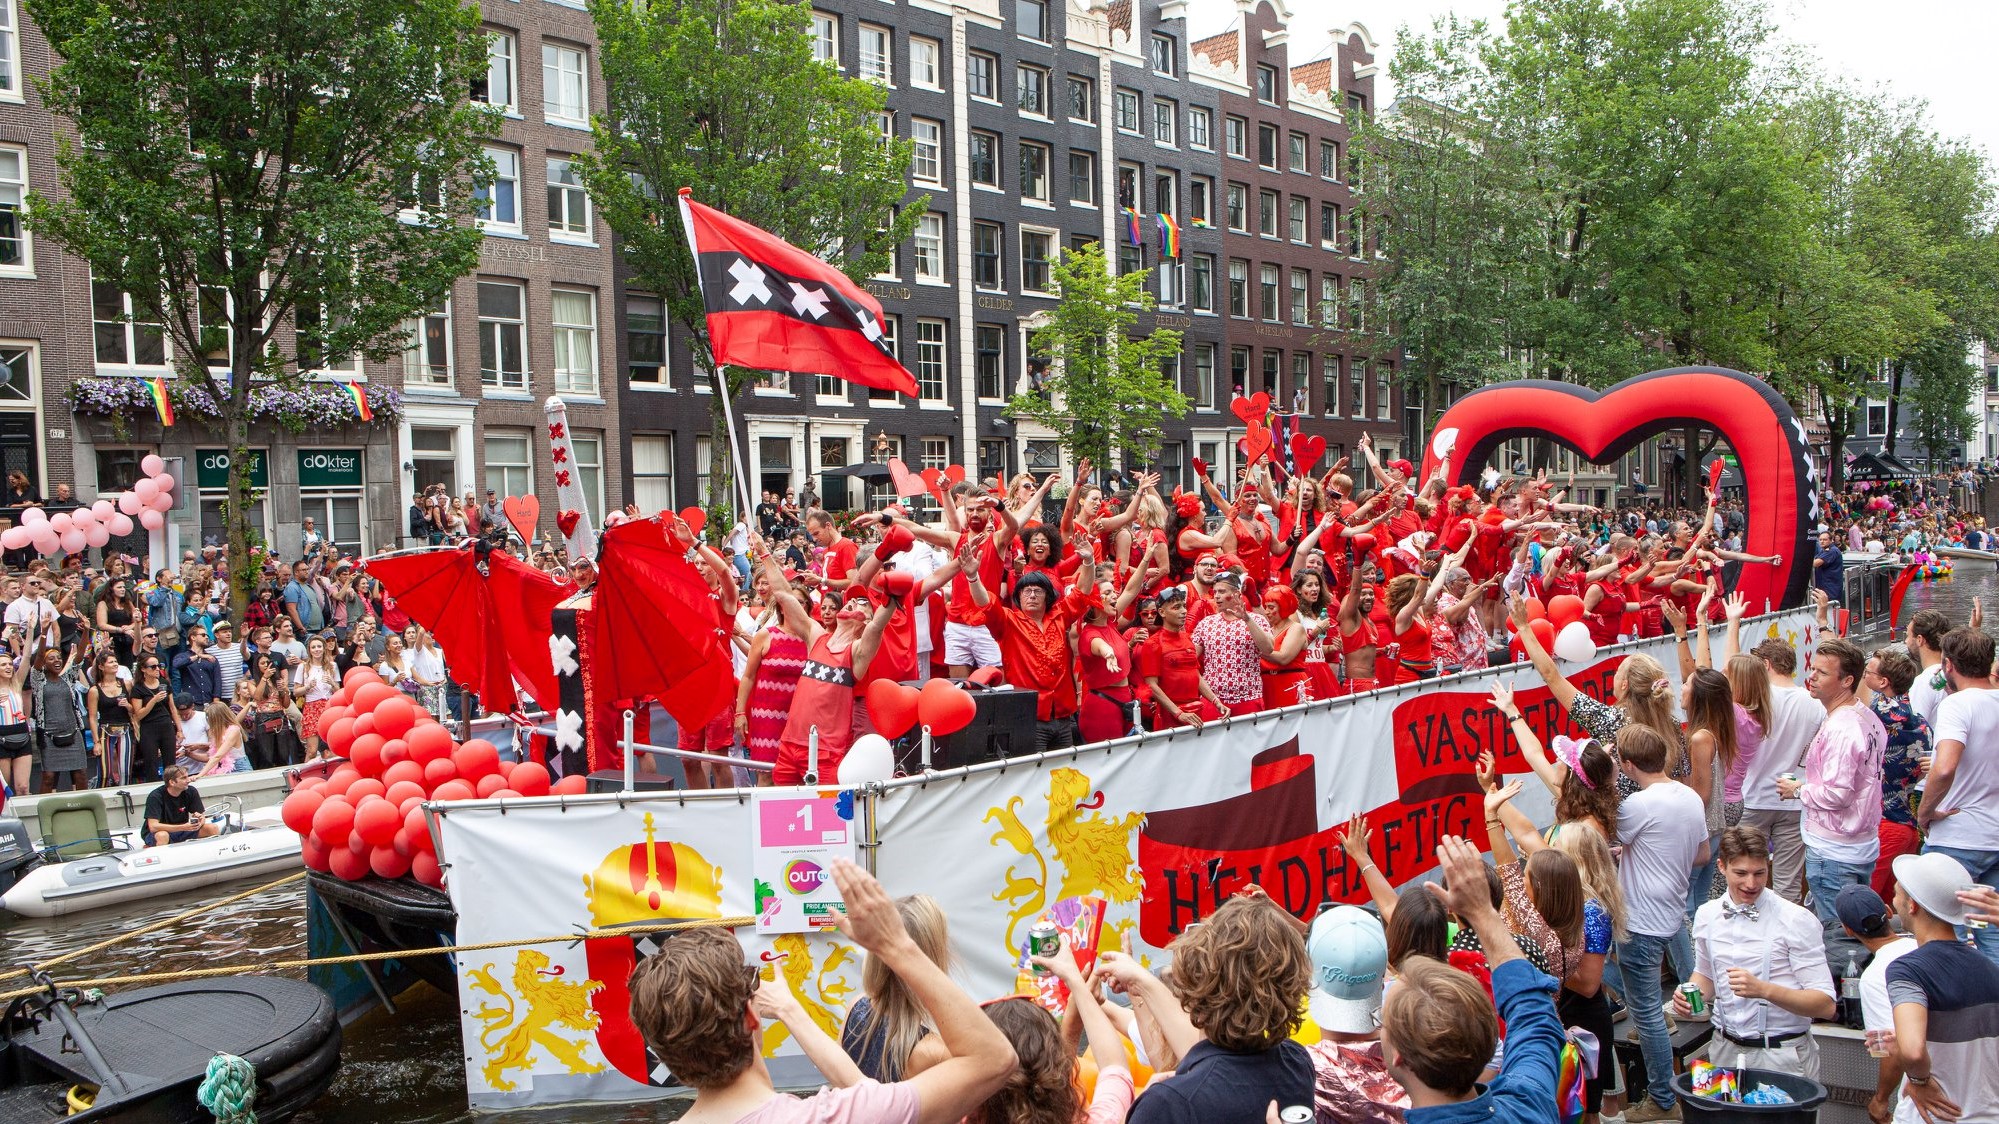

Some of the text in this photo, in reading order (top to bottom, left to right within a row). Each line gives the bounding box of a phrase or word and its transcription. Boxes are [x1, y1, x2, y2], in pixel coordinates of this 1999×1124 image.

[978, 296, 1014, 311] GELDER
[1155, 314, 1191, 328] ZEELAND
[1254, 325, 1294, 339] VRIESLAND
